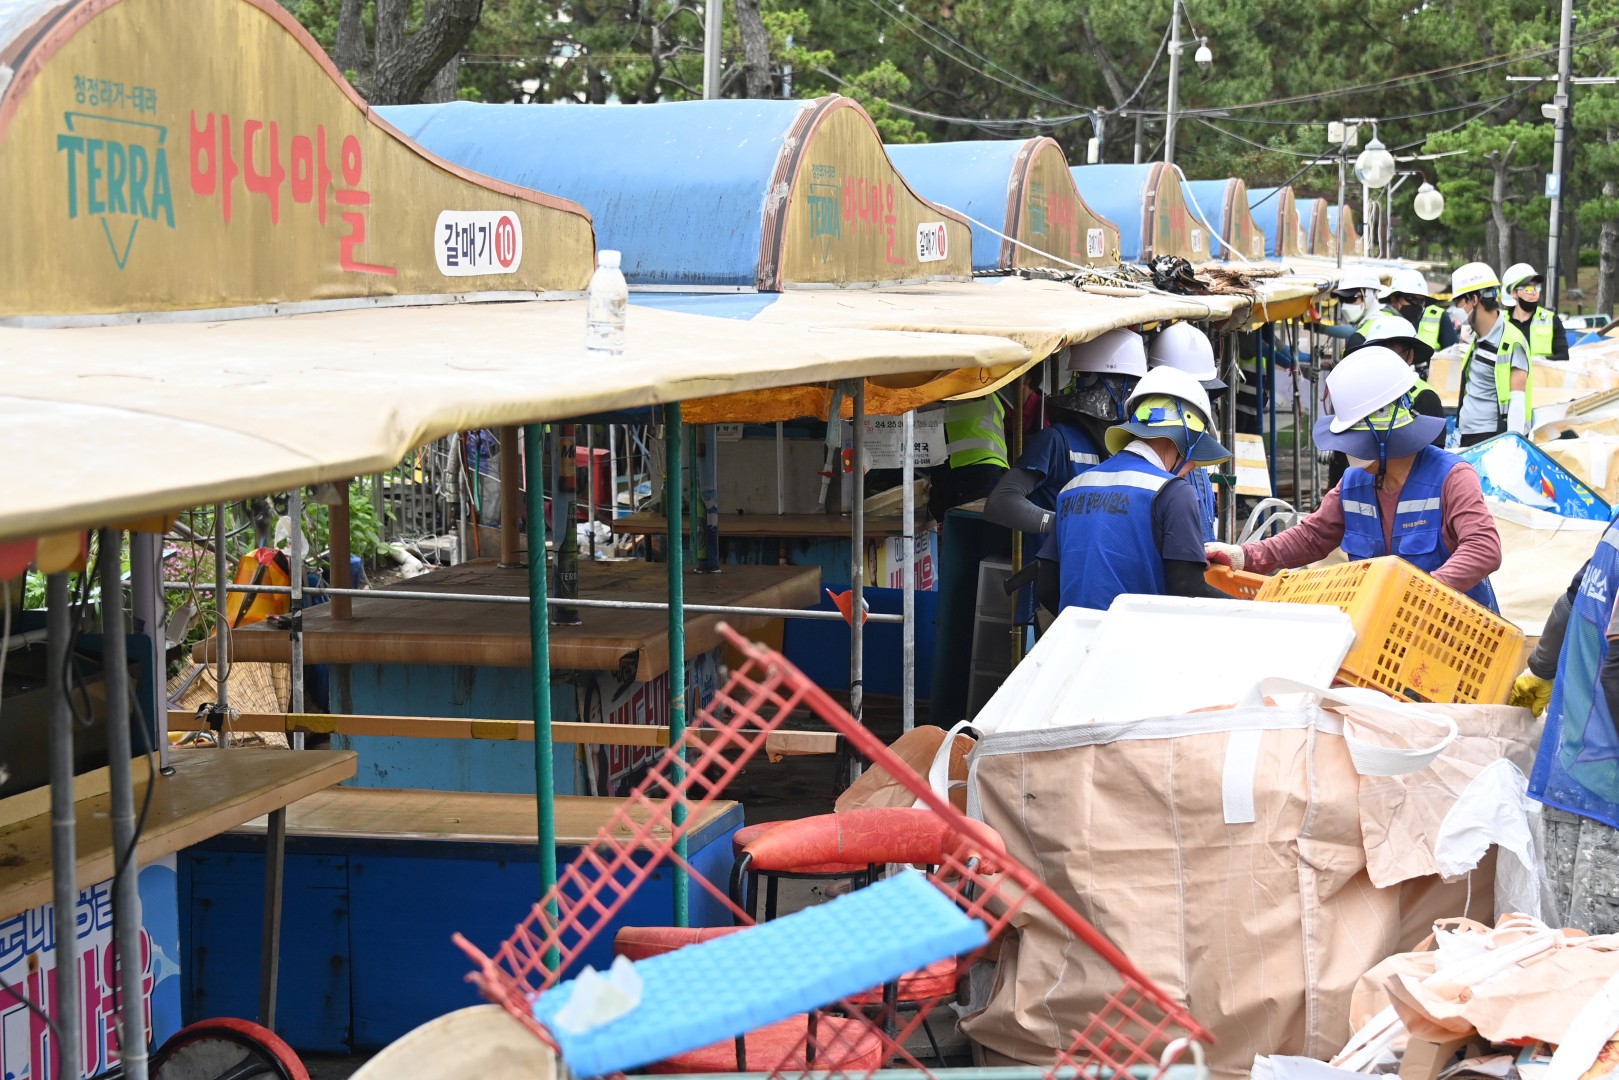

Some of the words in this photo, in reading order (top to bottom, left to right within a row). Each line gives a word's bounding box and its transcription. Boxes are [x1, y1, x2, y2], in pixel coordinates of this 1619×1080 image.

[57, 134, 176, 229] TERRA
[189, 109, 398, 276] 바다마을
[443, 219, 494, 268] 갈매기
[497, 222, 514, 262] 10
[843, 175, 906, 265] 바다마을
[919, 228, 938, 257] 갈매기
[875, 421, 885, 429] 24
[887, 421, 897, 429] 25
